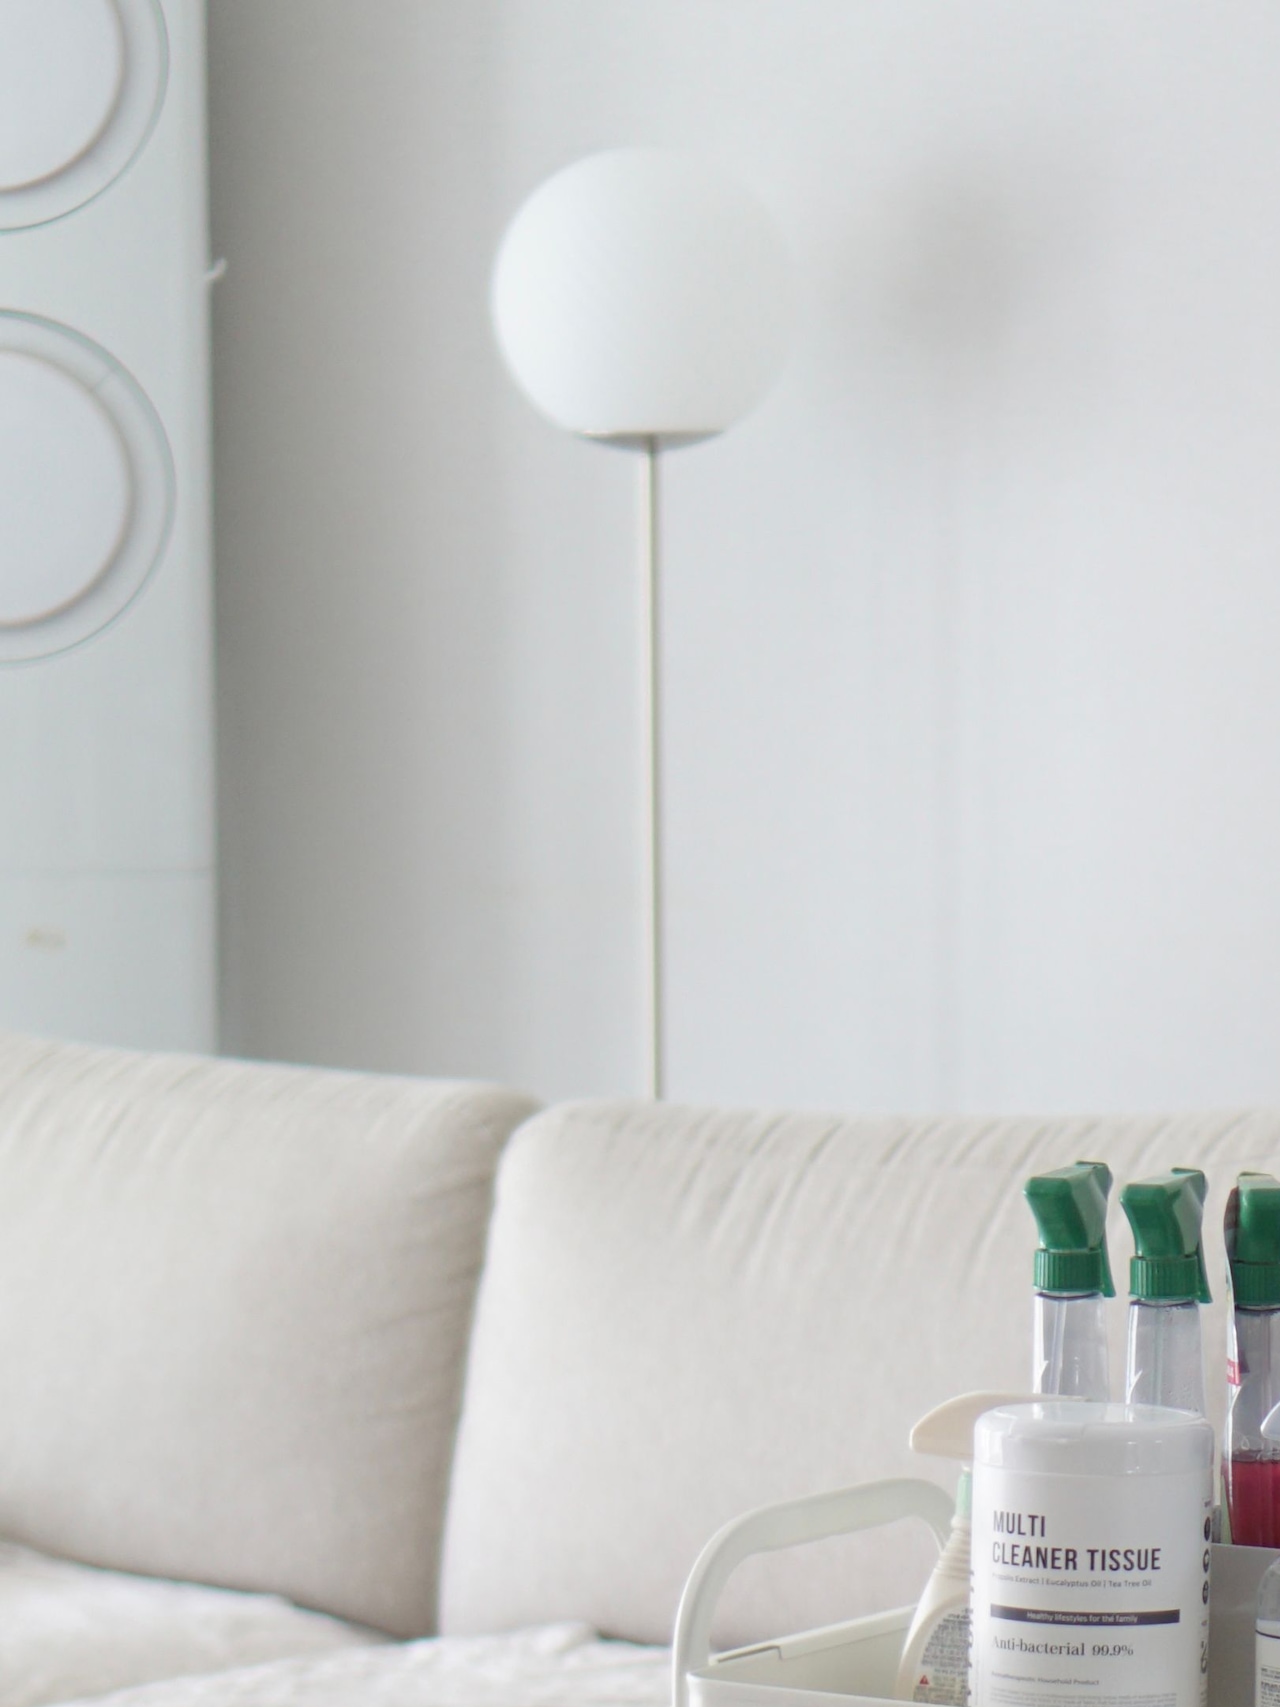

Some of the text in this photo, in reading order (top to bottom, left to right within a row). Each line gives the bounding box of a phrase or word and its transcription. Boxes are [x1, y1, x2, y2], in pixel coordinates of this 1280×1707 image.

[993, 1510, 1046, 1538] MULTI
[992, 1541, 1162, 1572] CLEANER TISSUE
[1015, 1574, 1041, 1585] Extract
[1045, 1577, 1089, 1589] Eucalyptus
[1090, 1579, 1102, 1588] Oil
[1108, 1580, 1122, 1588] Tea
[1124, 1580, 1141, 1588] Tree
[1141, 1579, 1153, 1588] Oil
[1026, 1611, 1054, 1623] Healthy
[1054, 1612, 1088, 1625] lifestyles
[1089, 1613, 1101, 1623] for
[1115, 1613, 1139, 1625] family
[992, 1636, 1135, 1657] Anti-bacterial 99.9%
